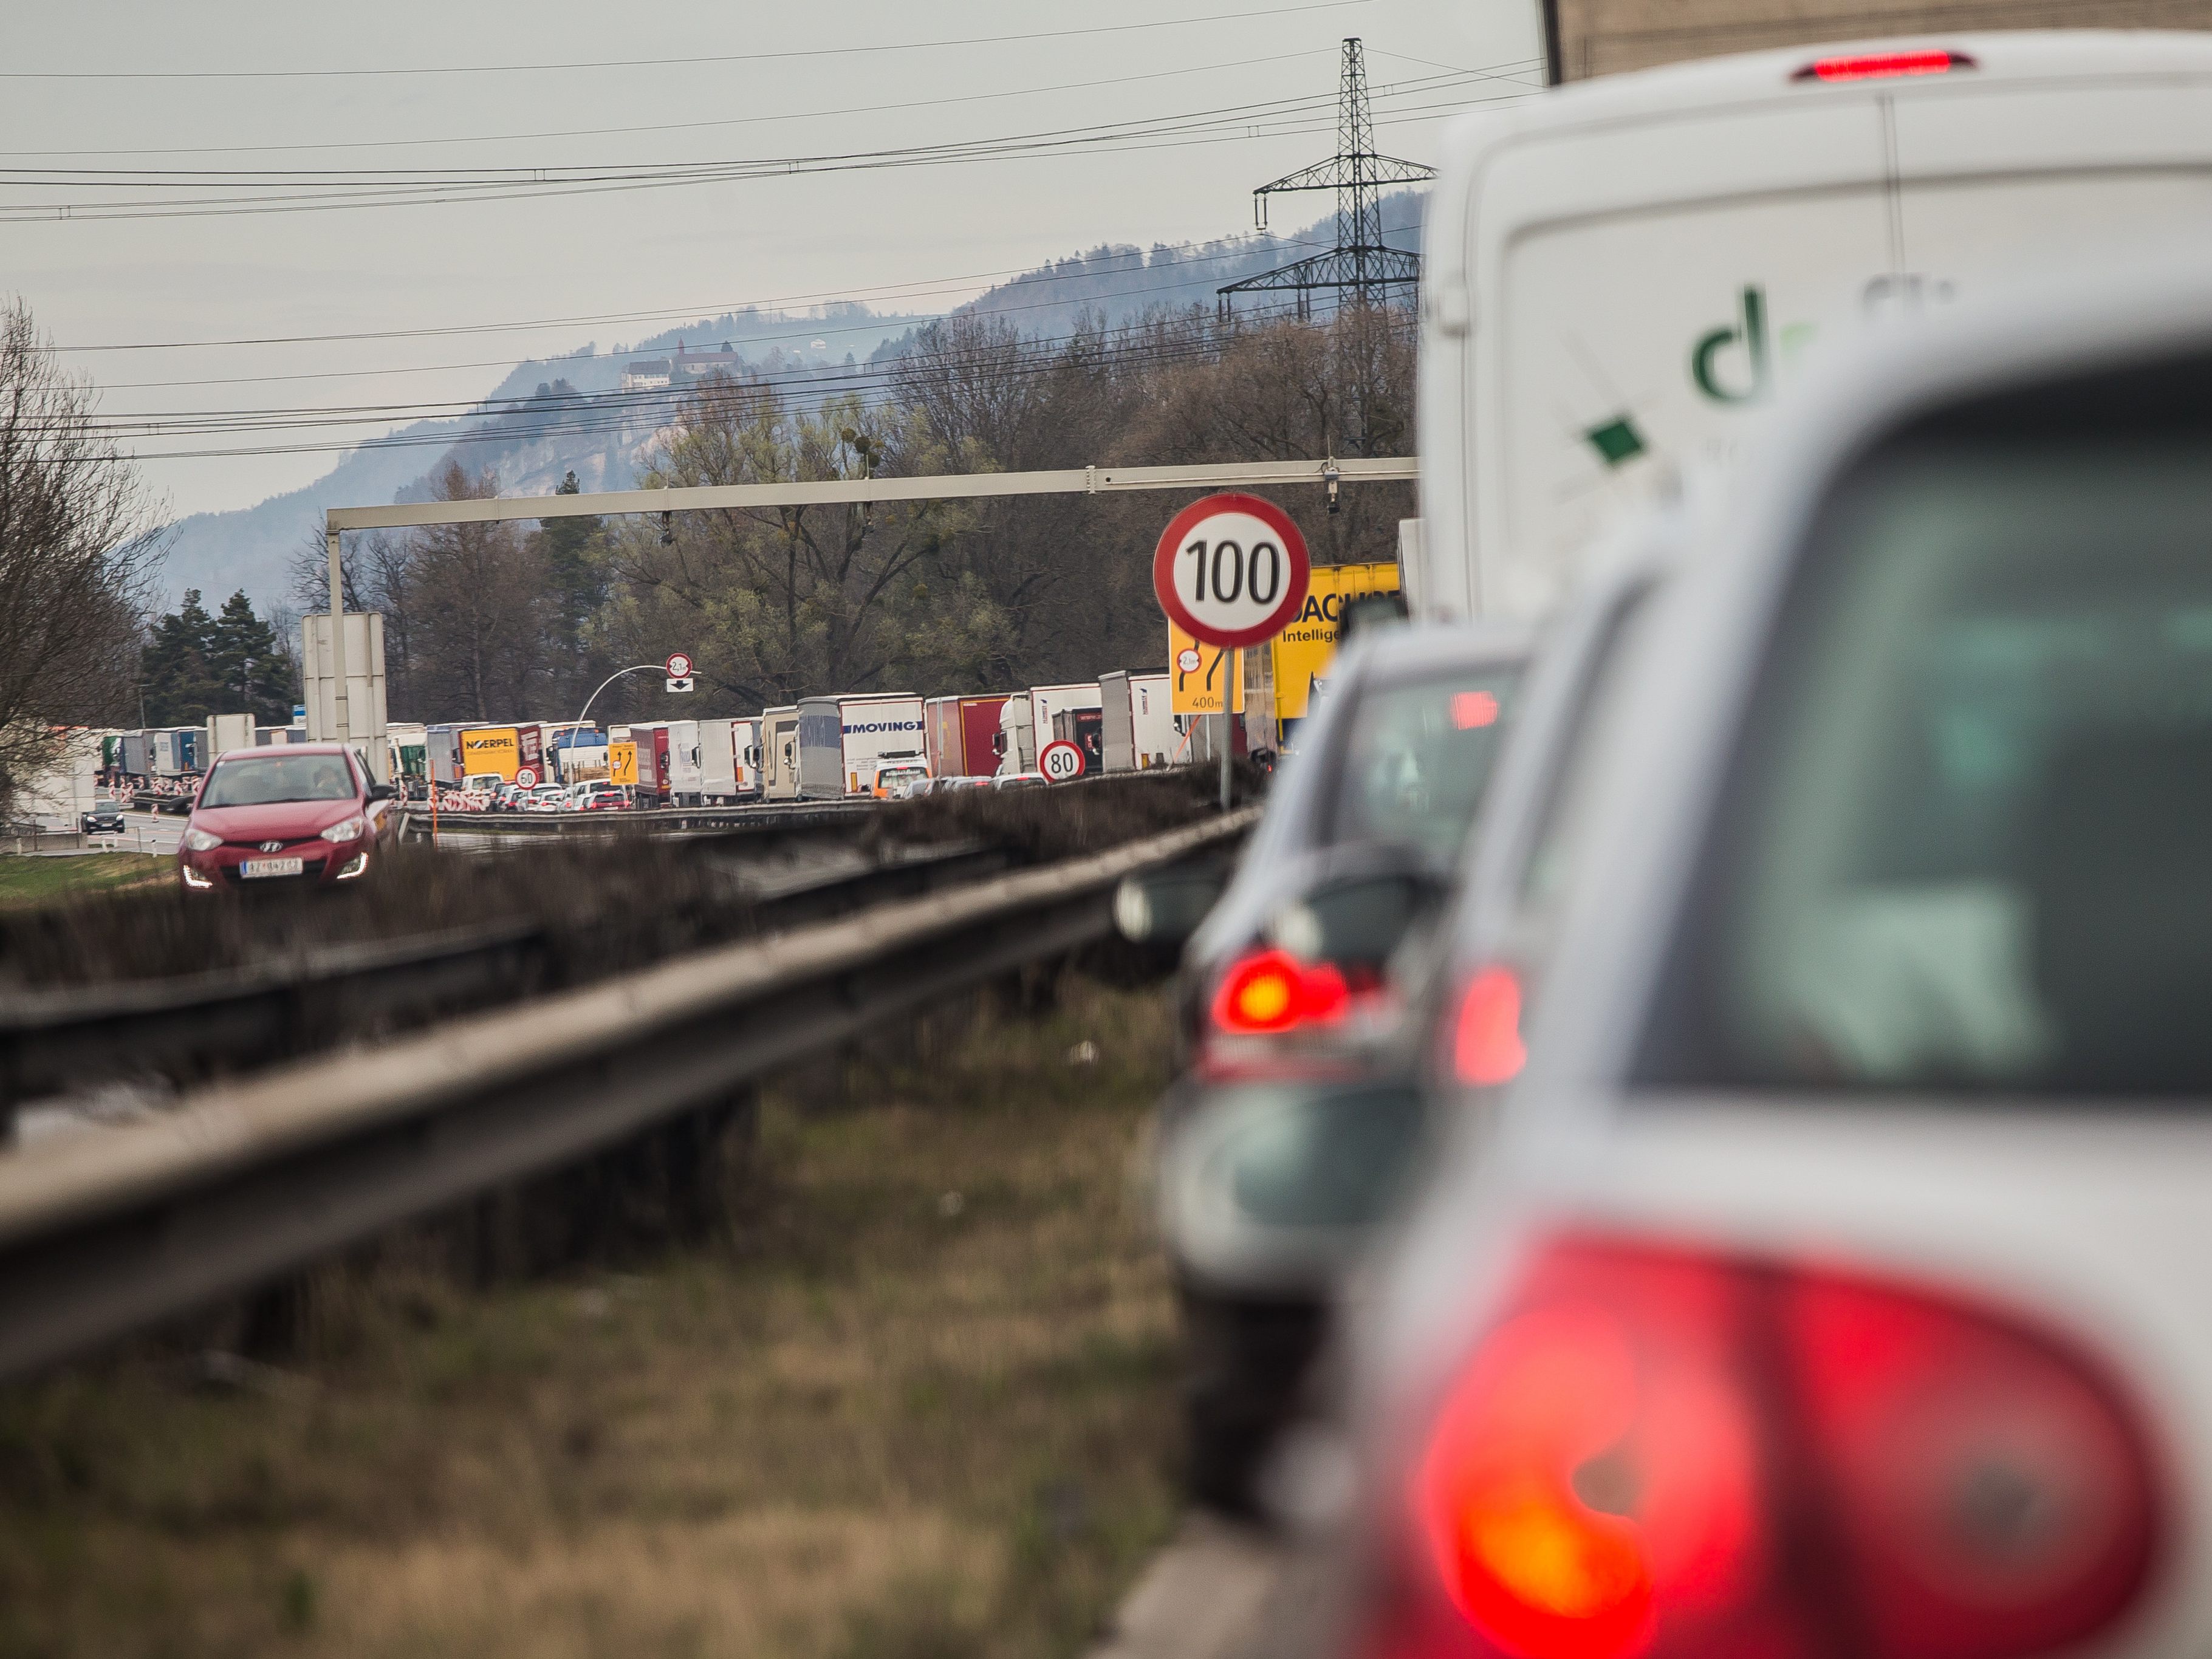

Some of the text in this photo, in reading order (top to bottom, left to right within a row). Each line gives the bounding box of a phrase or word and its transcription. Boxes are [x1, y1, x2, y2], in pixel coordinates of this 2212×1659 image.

[1185, 539, 1281, 606] 100
[1192, 696, 1222, 708] 400m
[852, 721, 916, 734] MOVING
[466, 738, 514, 750] NOERPEL
[1050, 752, 1073, 774] 80
[520, 773, 533, 784] 60
